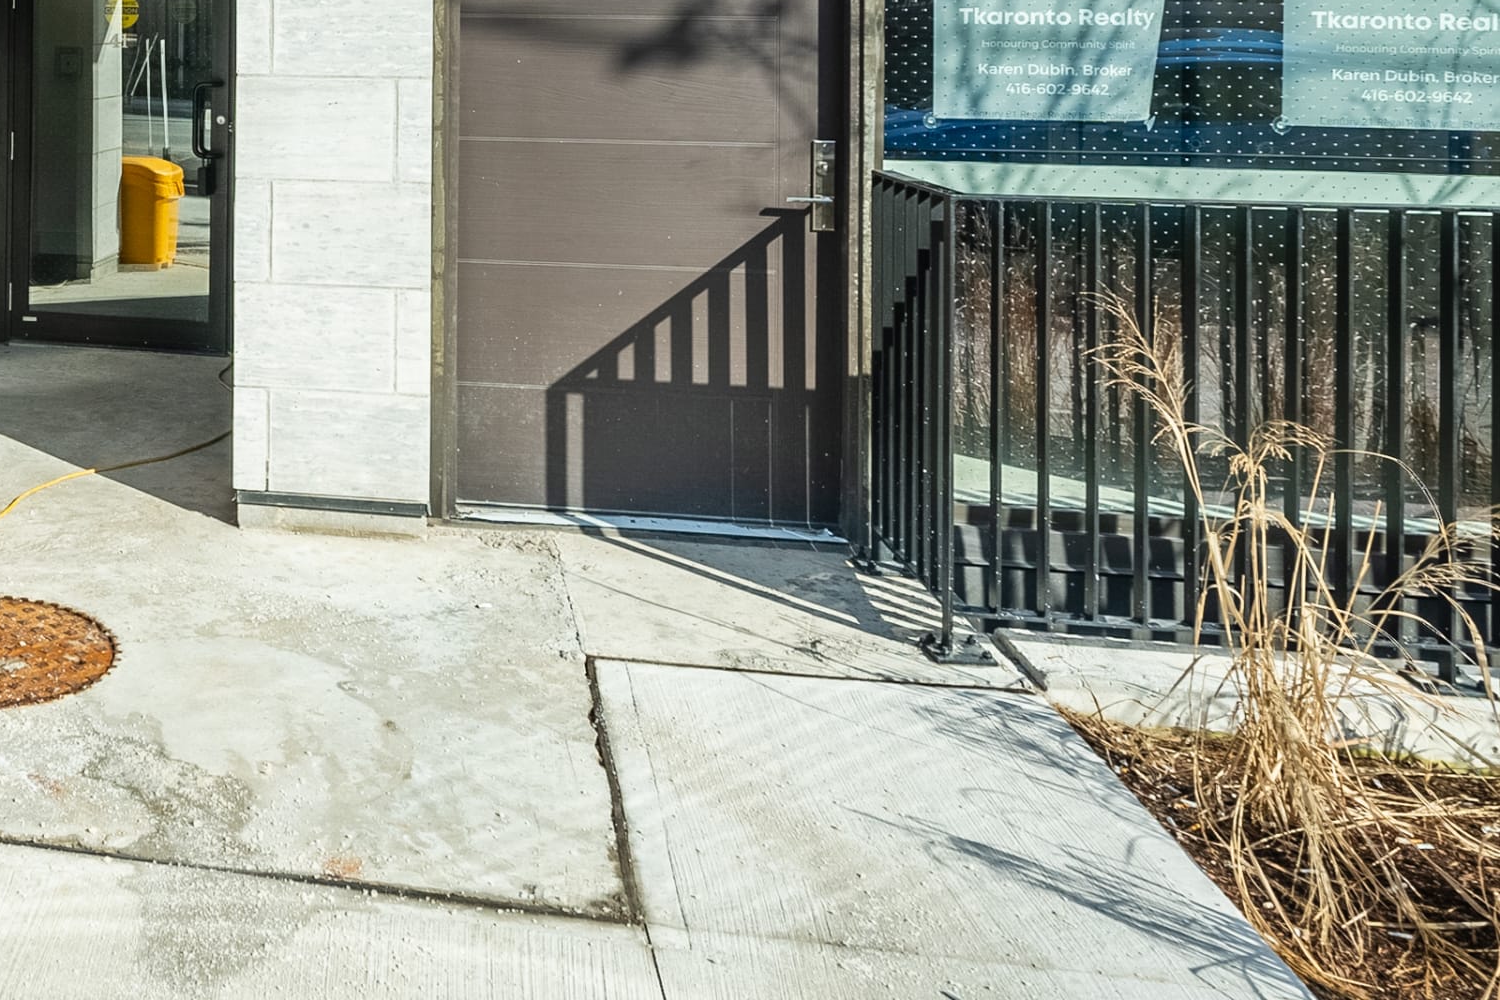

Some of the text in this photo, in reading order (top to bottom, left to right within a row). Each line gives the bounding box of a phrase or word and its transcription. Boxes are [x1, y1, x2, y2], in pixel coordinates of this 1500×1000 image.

[959, 7, 1155, 30] Tkaronto Realty
[1311, 11, 1432, 31] Tkaronto
[981, 39, 1136, 50] Honouring Community Spirit
[1335, 44, 1397, 55] Honouring
[1400, 45, 1469, 56] Community
[978, 63, 1023, 76] Karen
[1082, 64, 1133, 77] Broker
[1332, 68, 1500, 84] Karen Dubin, Broker
[1005, 82, 1109, 96] 416-602-9642
[1361, 89, 1473, 104] 416-602-9642
